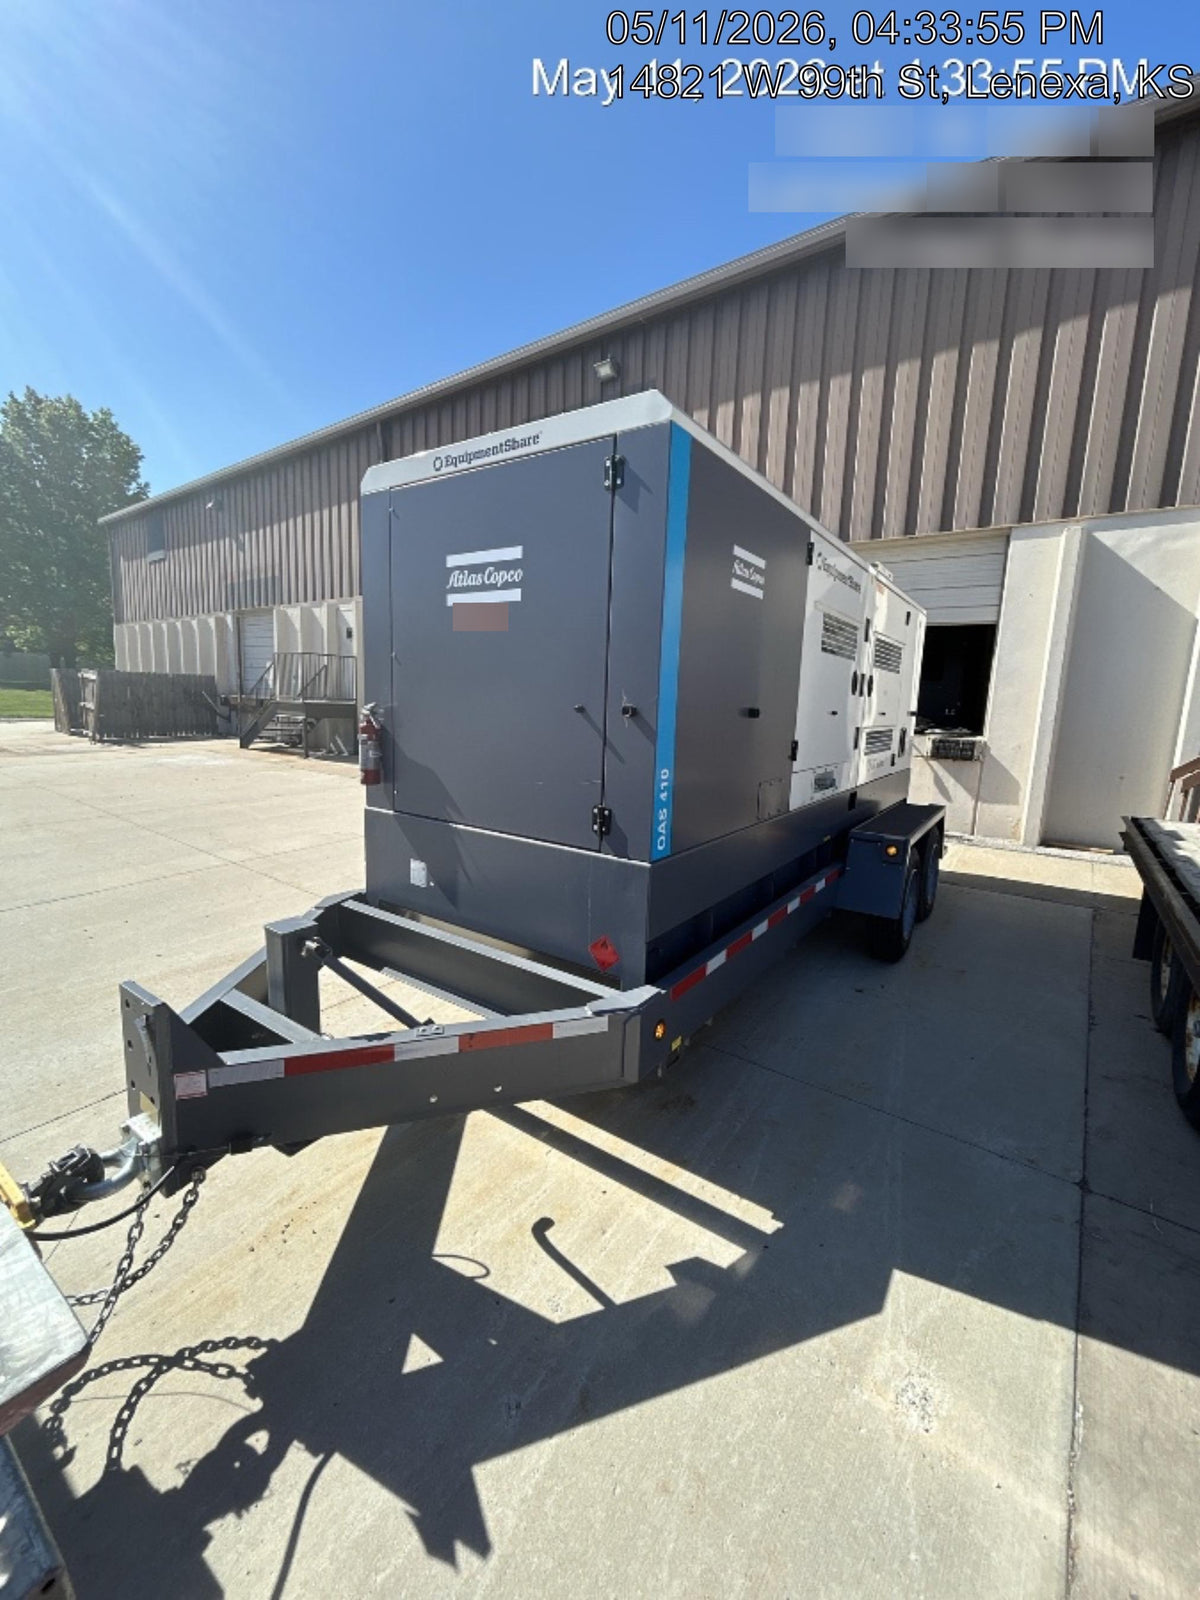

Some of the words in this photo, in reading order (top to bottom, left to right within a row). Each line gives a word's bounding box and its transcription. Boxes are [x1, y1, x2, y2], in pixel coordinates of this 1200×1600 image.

[444, 433, 540, 468] EquipmentShare
[446, 569, 483, 589] Atlas
[484, 566, 523, 588] Copco
